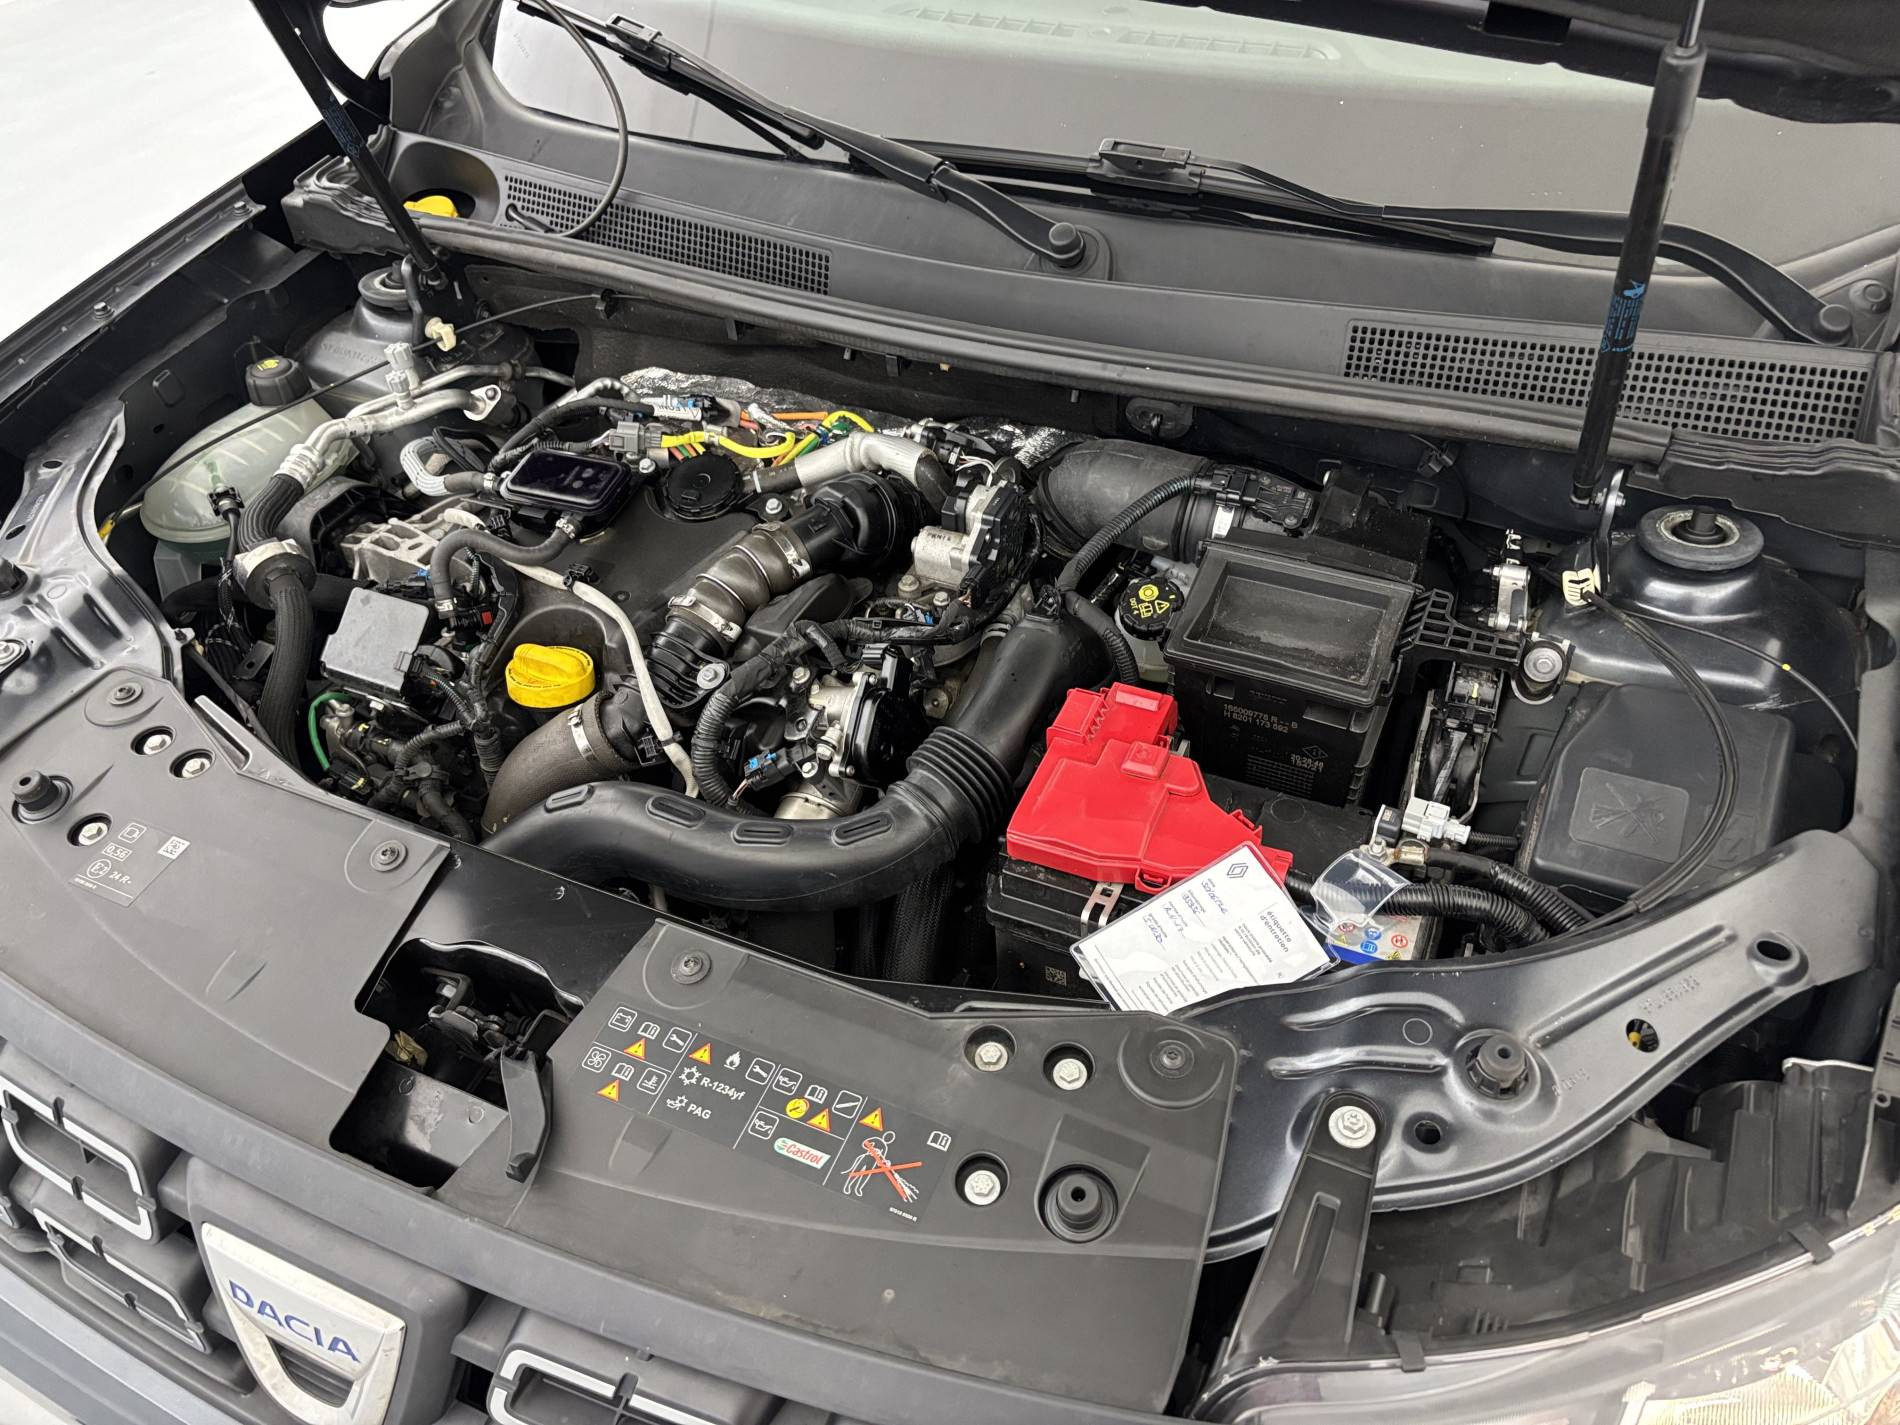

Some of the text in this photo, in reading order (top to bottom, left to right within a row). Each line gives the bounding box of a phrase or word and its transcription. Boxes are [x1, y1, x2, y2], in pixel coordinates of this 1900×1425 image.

[1130, 597, 1139, 609] DOT
[1255, 718, 1271, 729] 173
[91, 862, 108, 875] E2
[700, 1077, 746, 1101] R-1234yf
[686, 1103, 712, 1119] PAG
[786, 1143, 823, 1165] Castrol
[228, 1279, 361, 1364] DACIA
